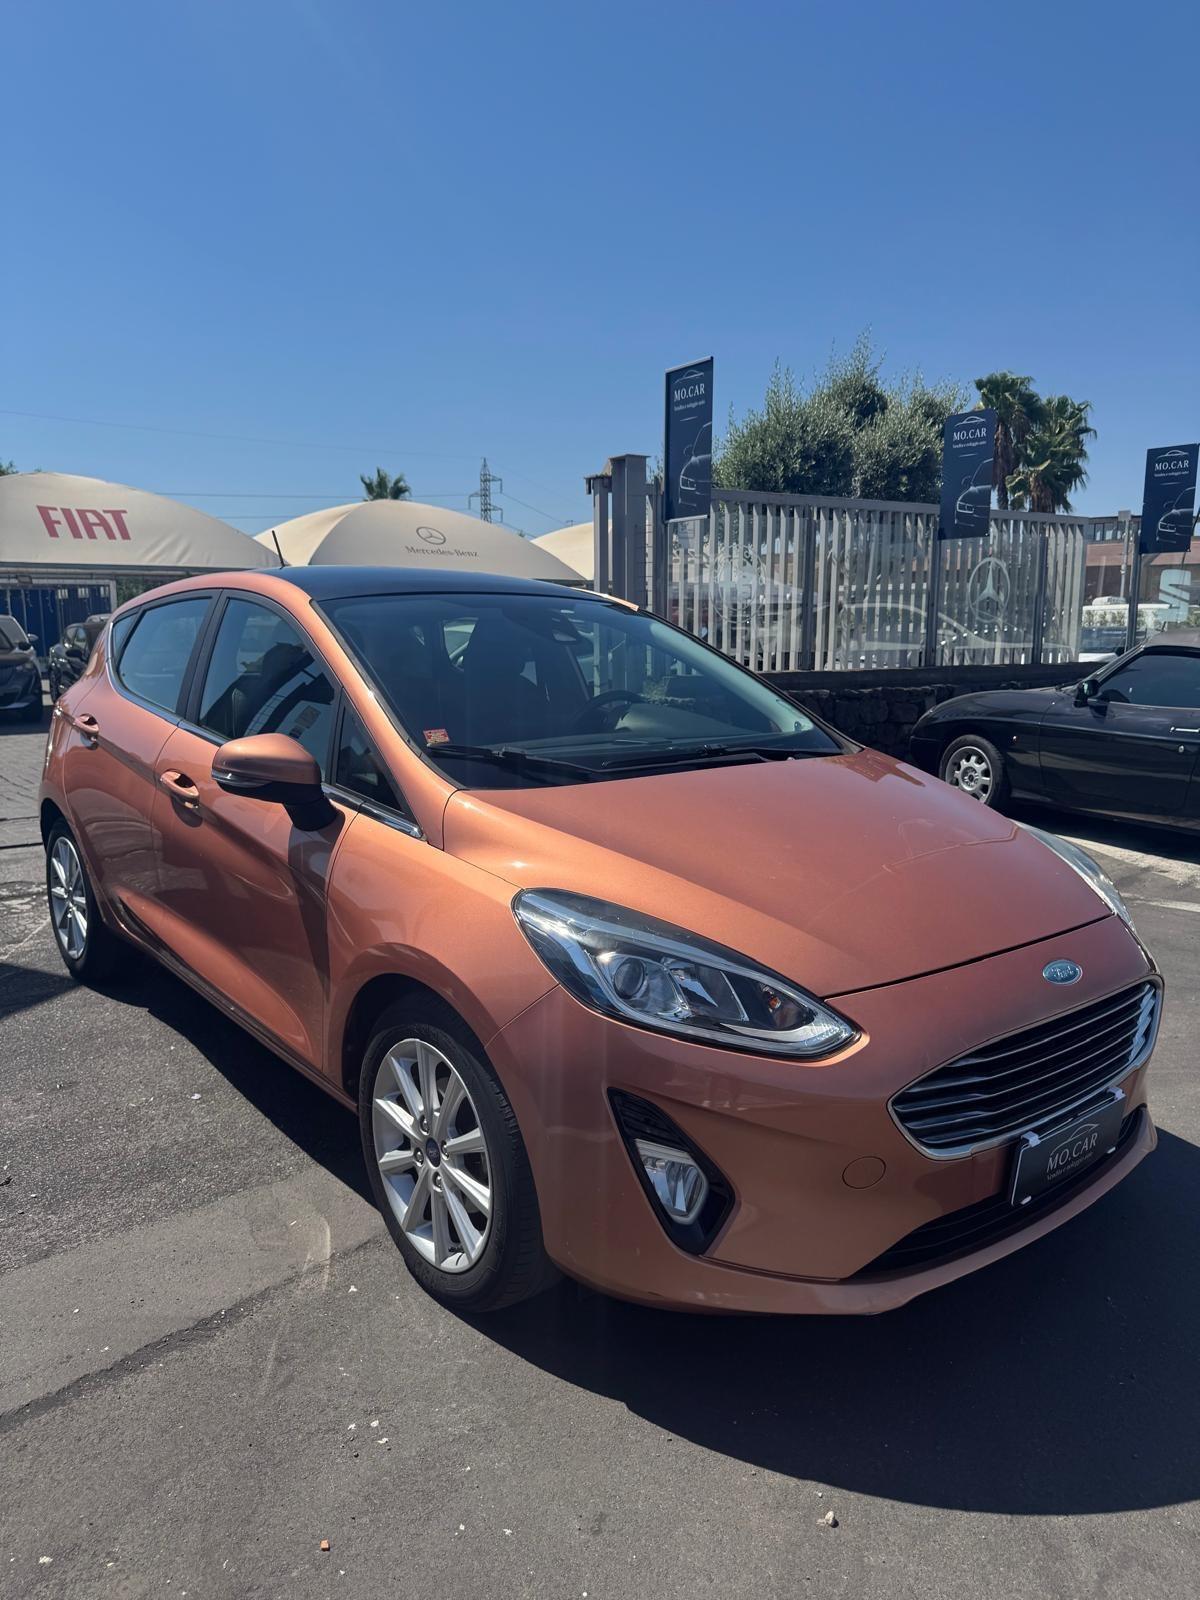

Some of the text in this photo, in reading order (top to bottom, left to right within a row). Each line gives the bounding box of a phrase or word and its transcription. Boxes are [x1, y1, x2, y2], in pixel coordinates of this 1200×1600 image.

[674, 383, 705, 402] MO.CAR
[953, 427, 987, 441] MO.CAR
[1155, 460, 1189, 471] MO.CAR
[36, 505, 131, 540] FIAT
[405, 545, 478, 558] Mercedes-Benz
[1047, 1132, 1098, 1173] MO.CAR
